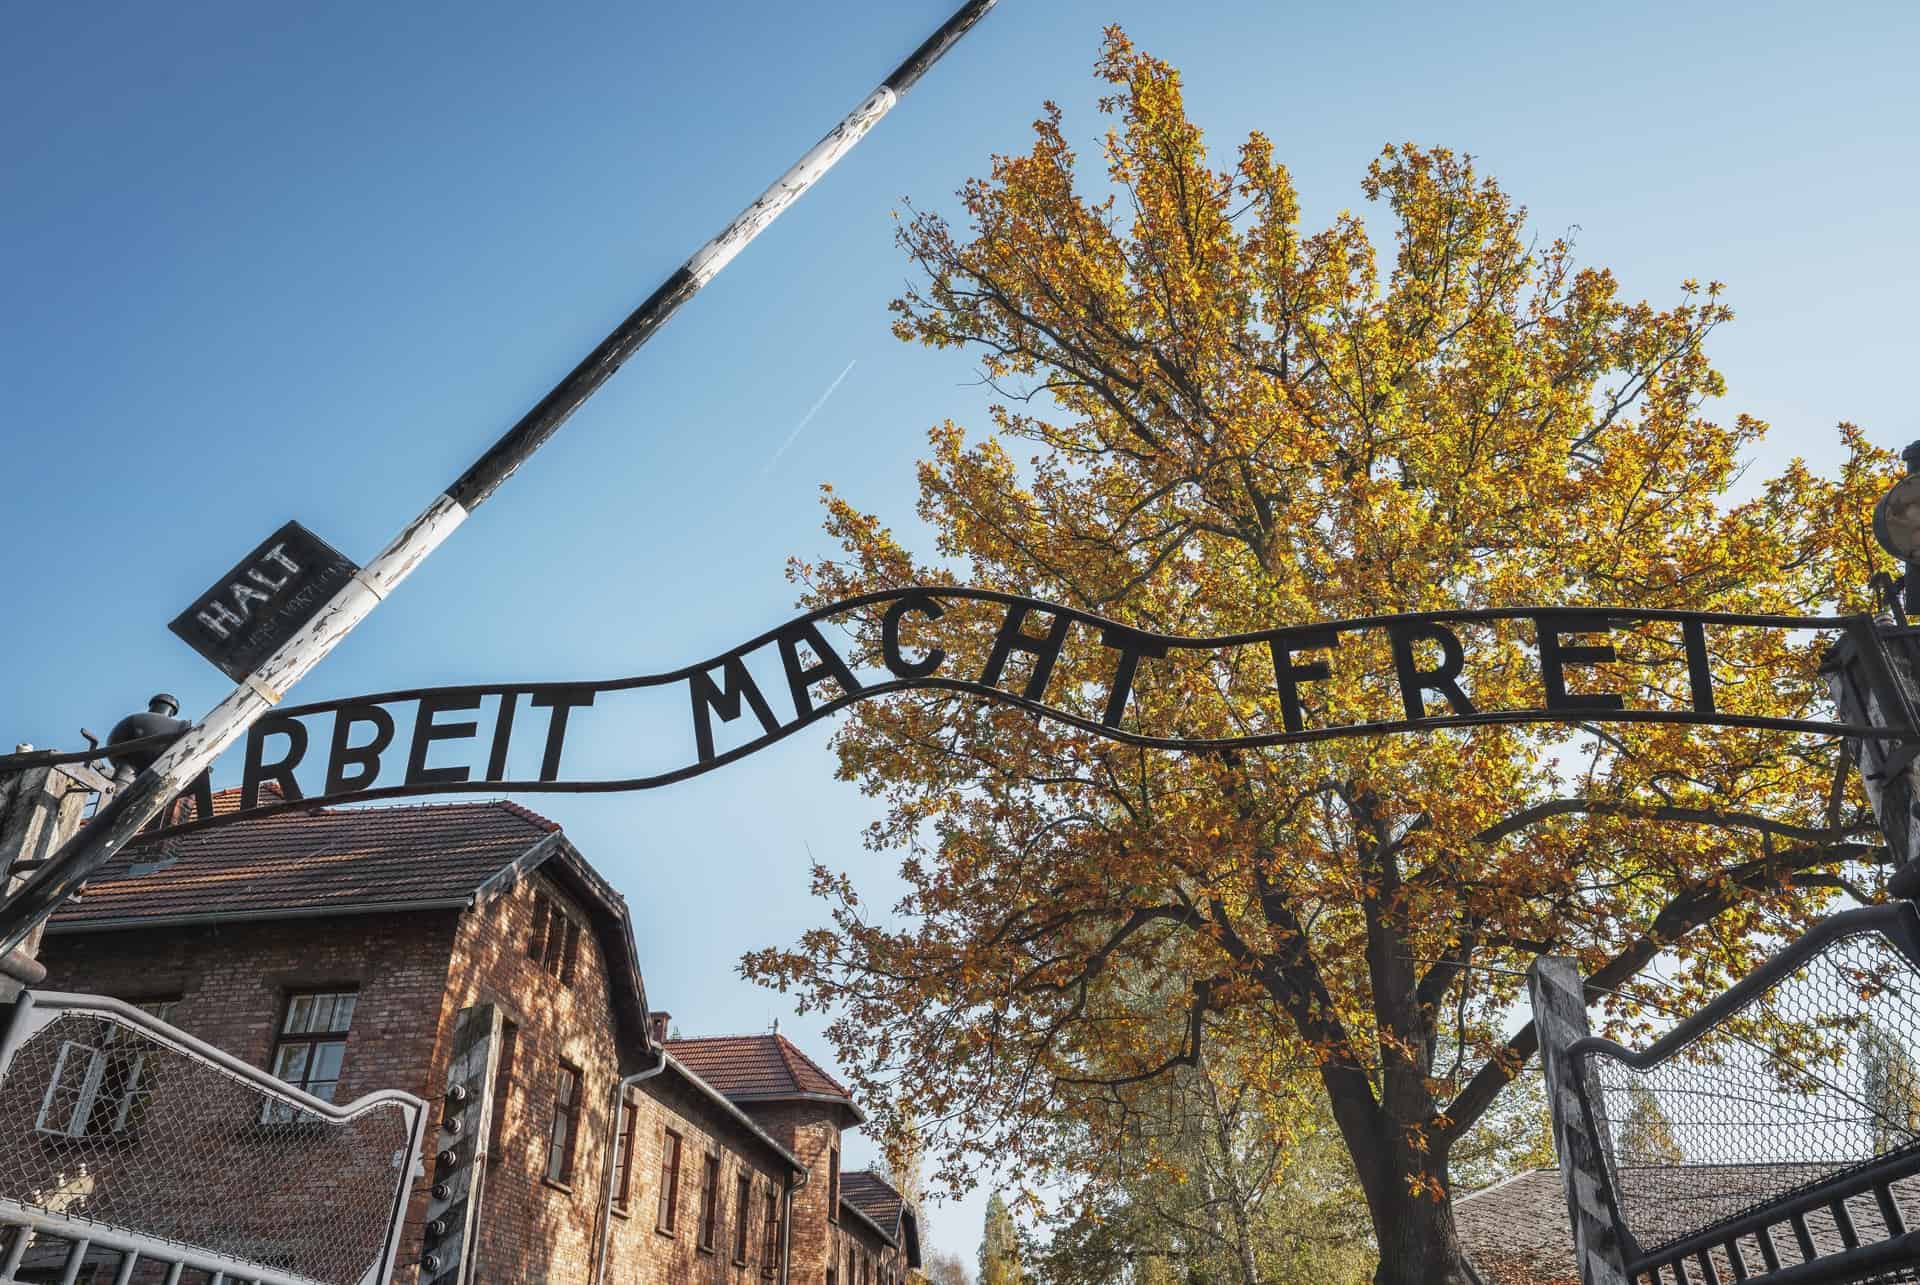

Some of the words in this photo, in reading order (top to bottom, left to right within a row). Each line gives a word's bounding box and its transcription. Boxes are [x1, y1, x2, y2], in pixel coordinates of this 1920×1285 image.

[197, 543, 300, 640] HALT
[689, 598, 1168, 765] MACHT
[1269, 615, 1717, 732] FREI
